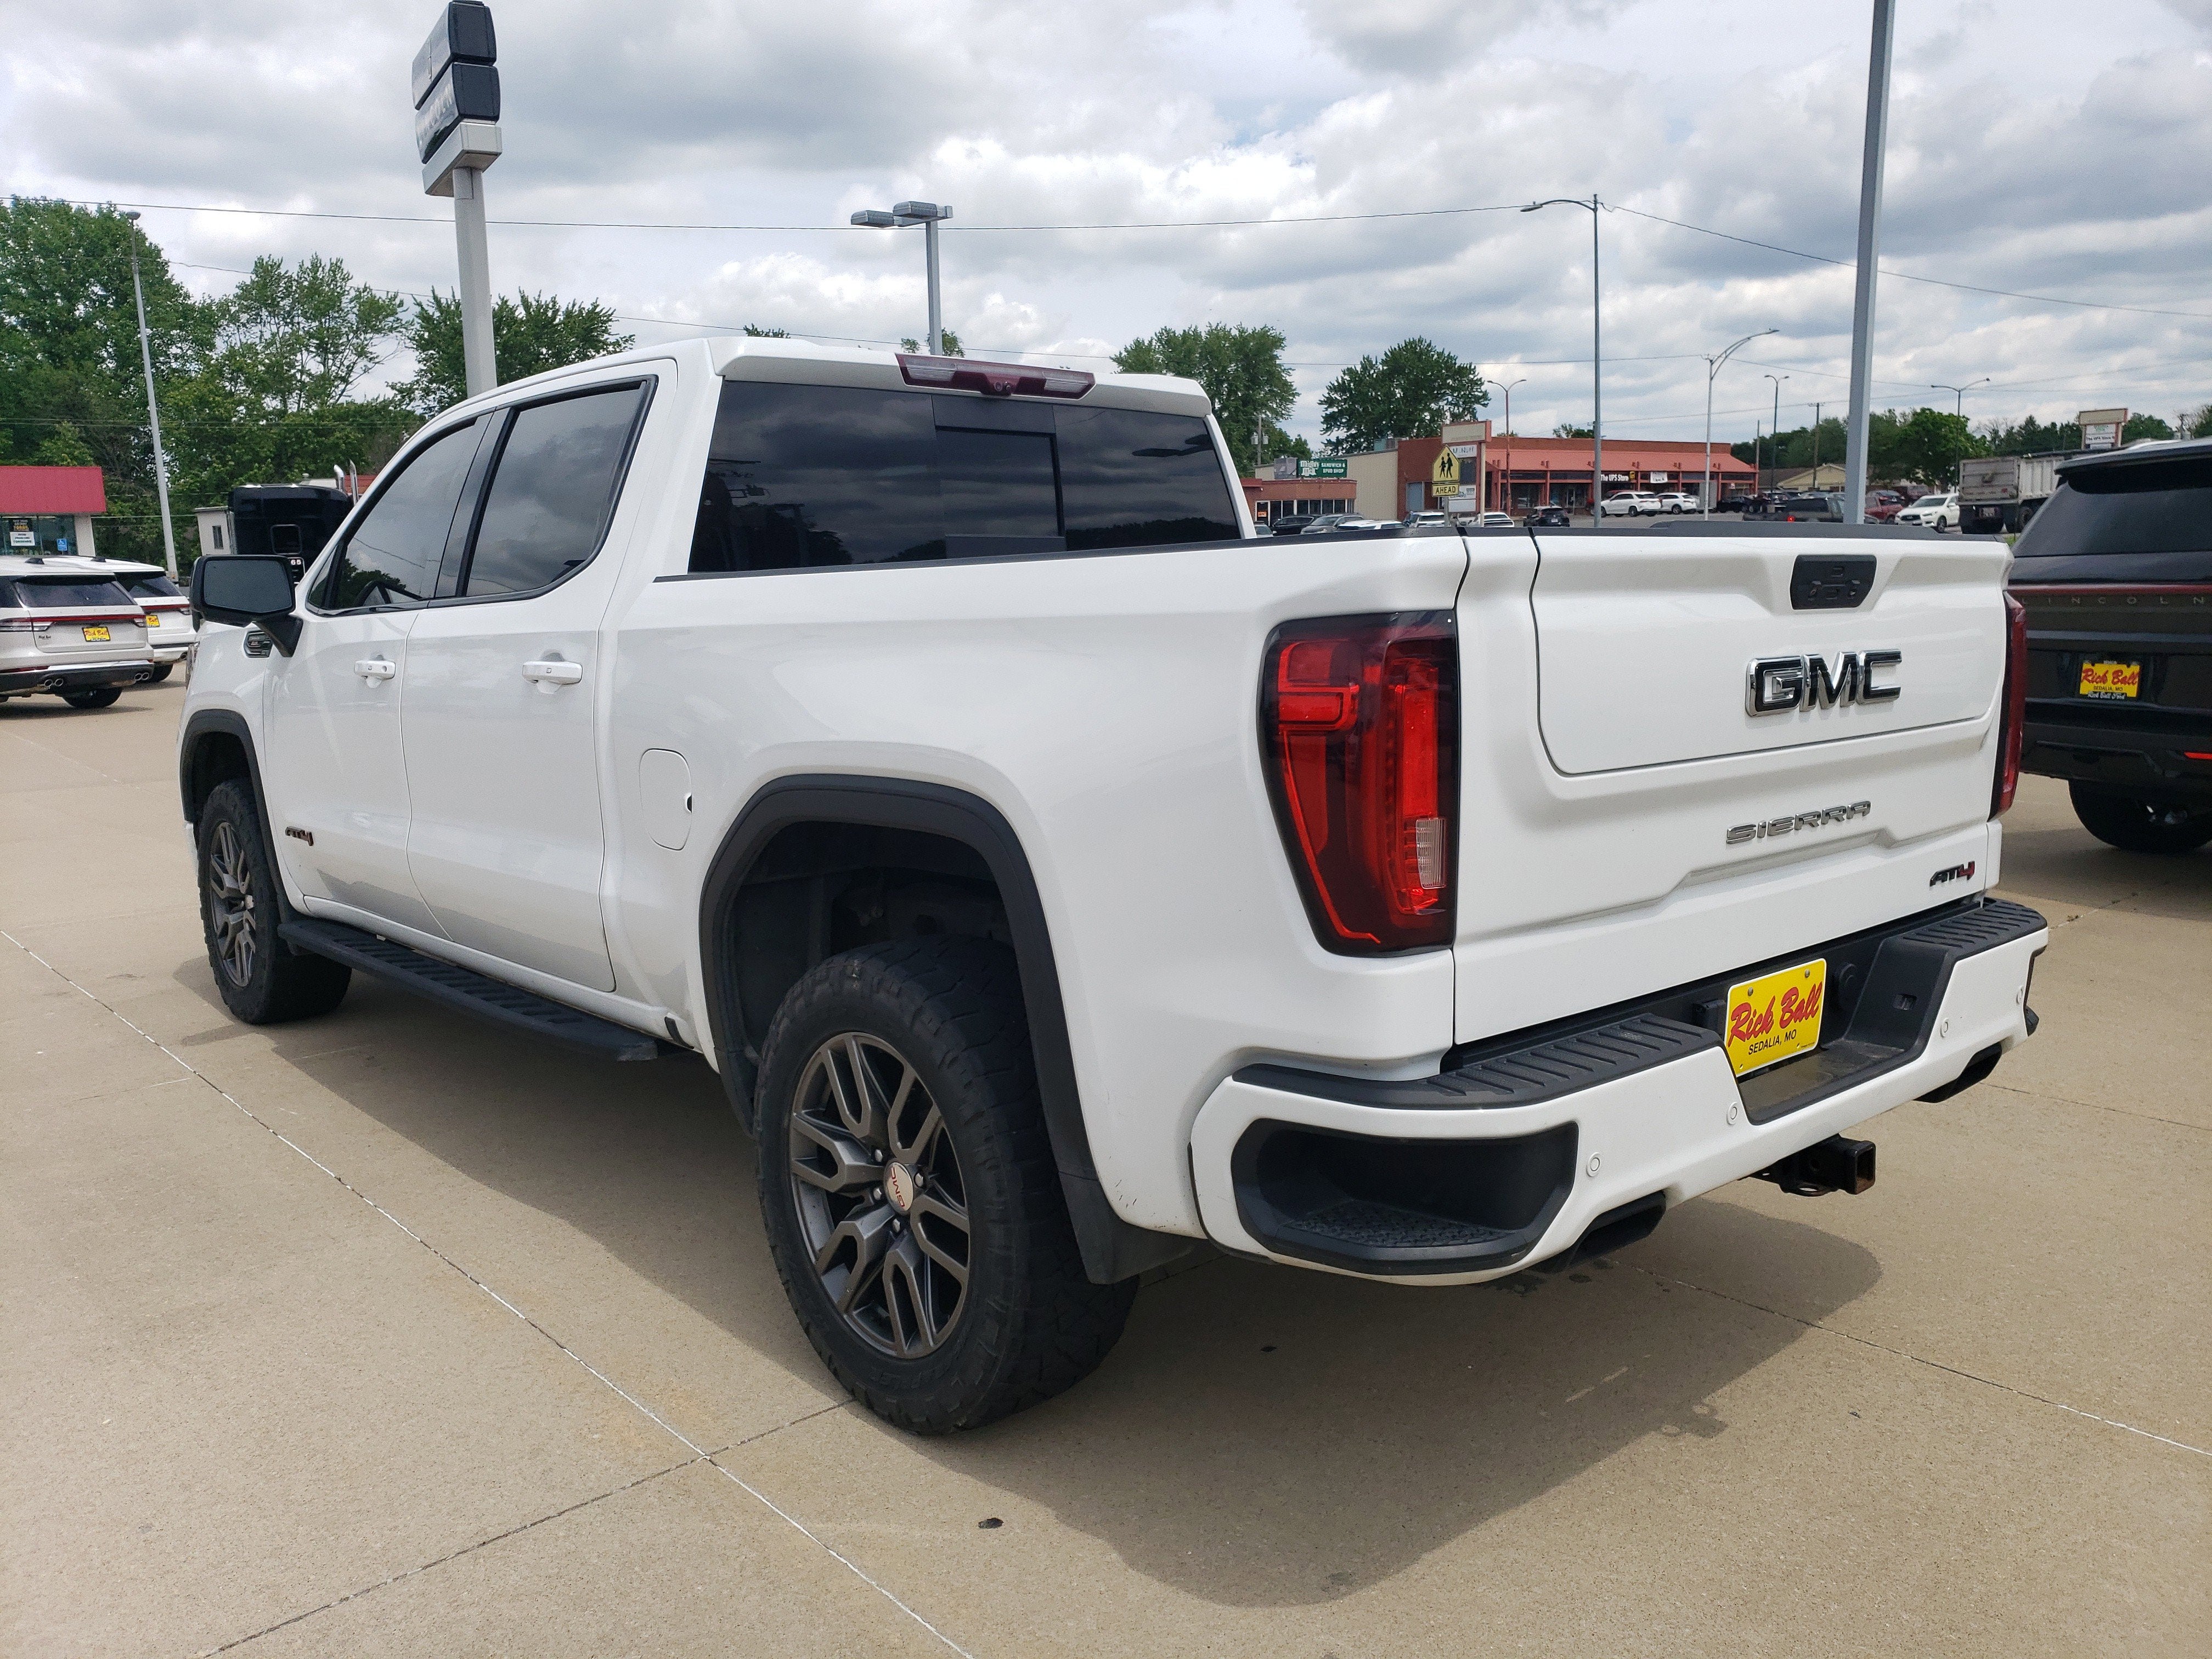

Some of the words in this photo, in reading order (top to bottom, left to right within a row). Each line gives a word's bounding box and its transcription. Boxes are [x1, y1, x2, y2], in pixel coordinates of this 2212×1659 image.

[2022, 596, 2204, 605] LINCOLN
[1745, 648, 1902, 717] GMC
[2081, 668, 2109, 685] Rick
[2112, 669, 2140, 685] Ball
[1726, 800, 1871, 844] SIERRA
[1929, 860, 1975, 887] AT4
[1728, 995, 1776, 1048] Rick
[1779, 981, 1822, 1029] Ball
[1748, 1035, 1782, 1056] SEDALIA,
[1784, 1029, 1797, 1043] MO
[890, 1167, 905, 1207] GMC
